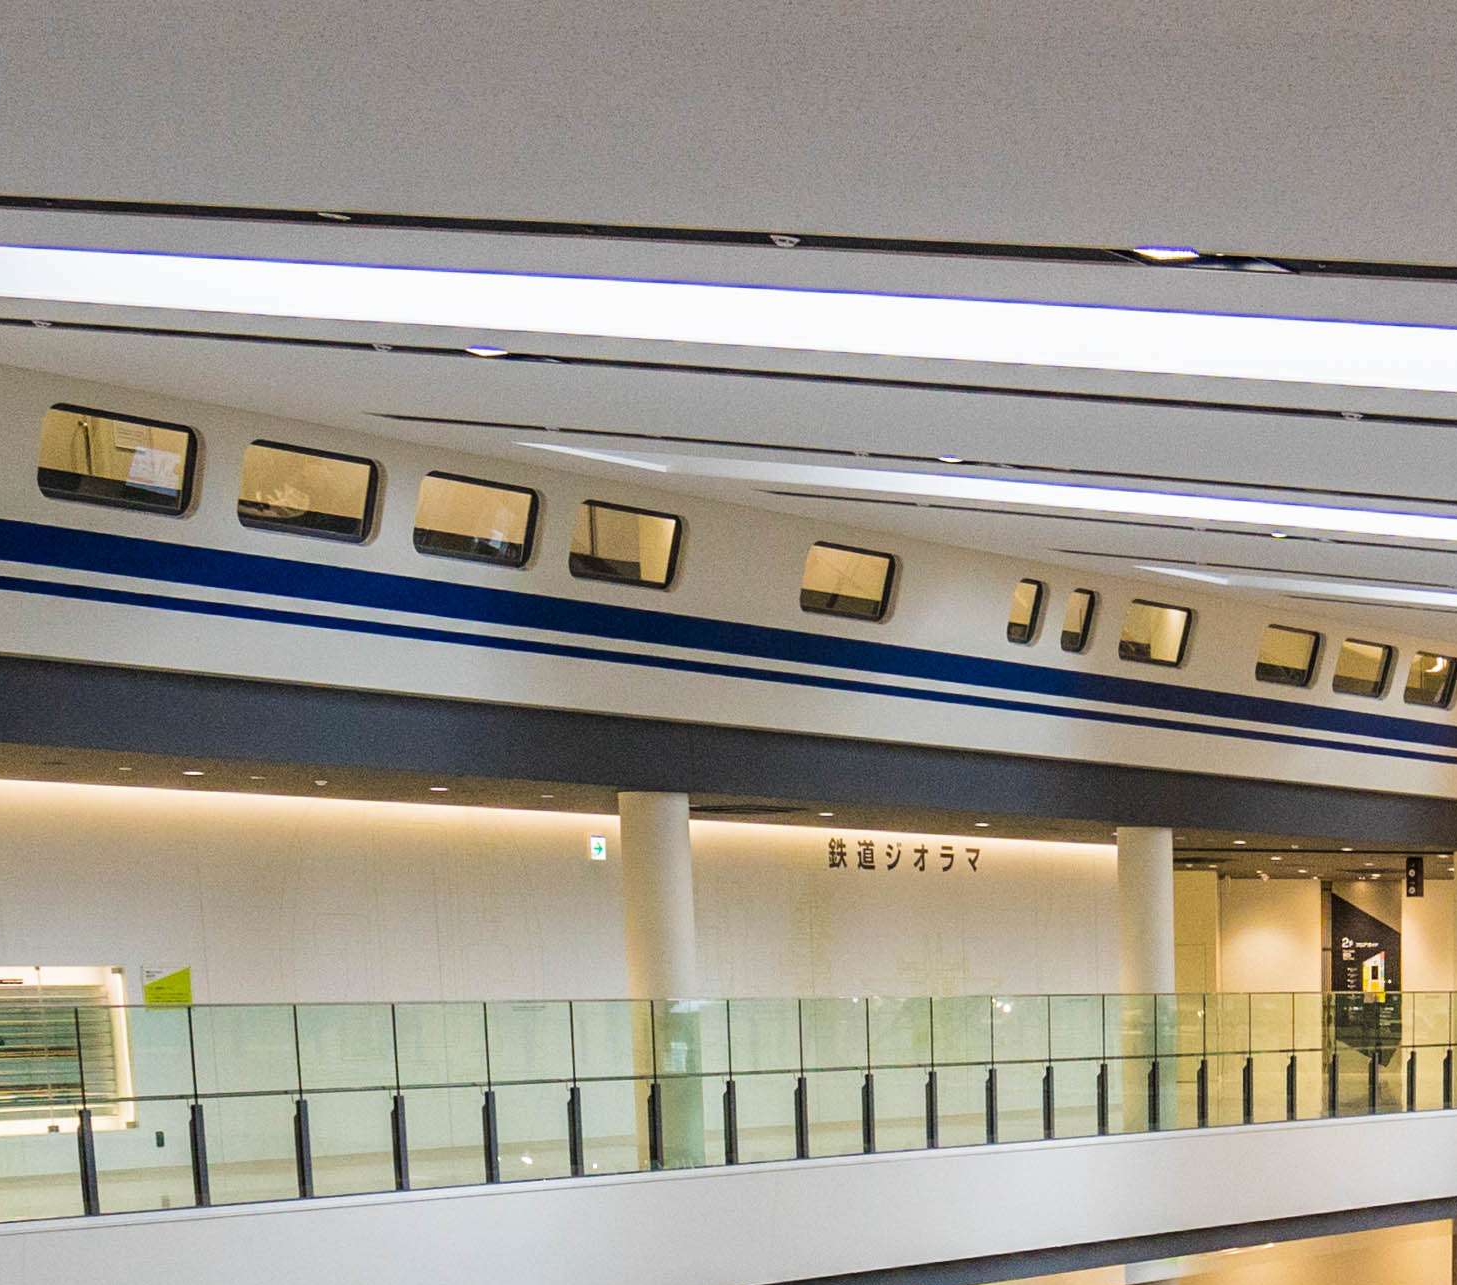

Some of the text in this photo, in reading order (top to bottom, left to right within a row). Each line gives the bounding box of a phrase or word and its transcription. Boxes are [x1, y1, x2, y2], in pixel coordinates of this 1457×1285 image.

[828, 837, 981, 872] 鉄道ジオラマ
